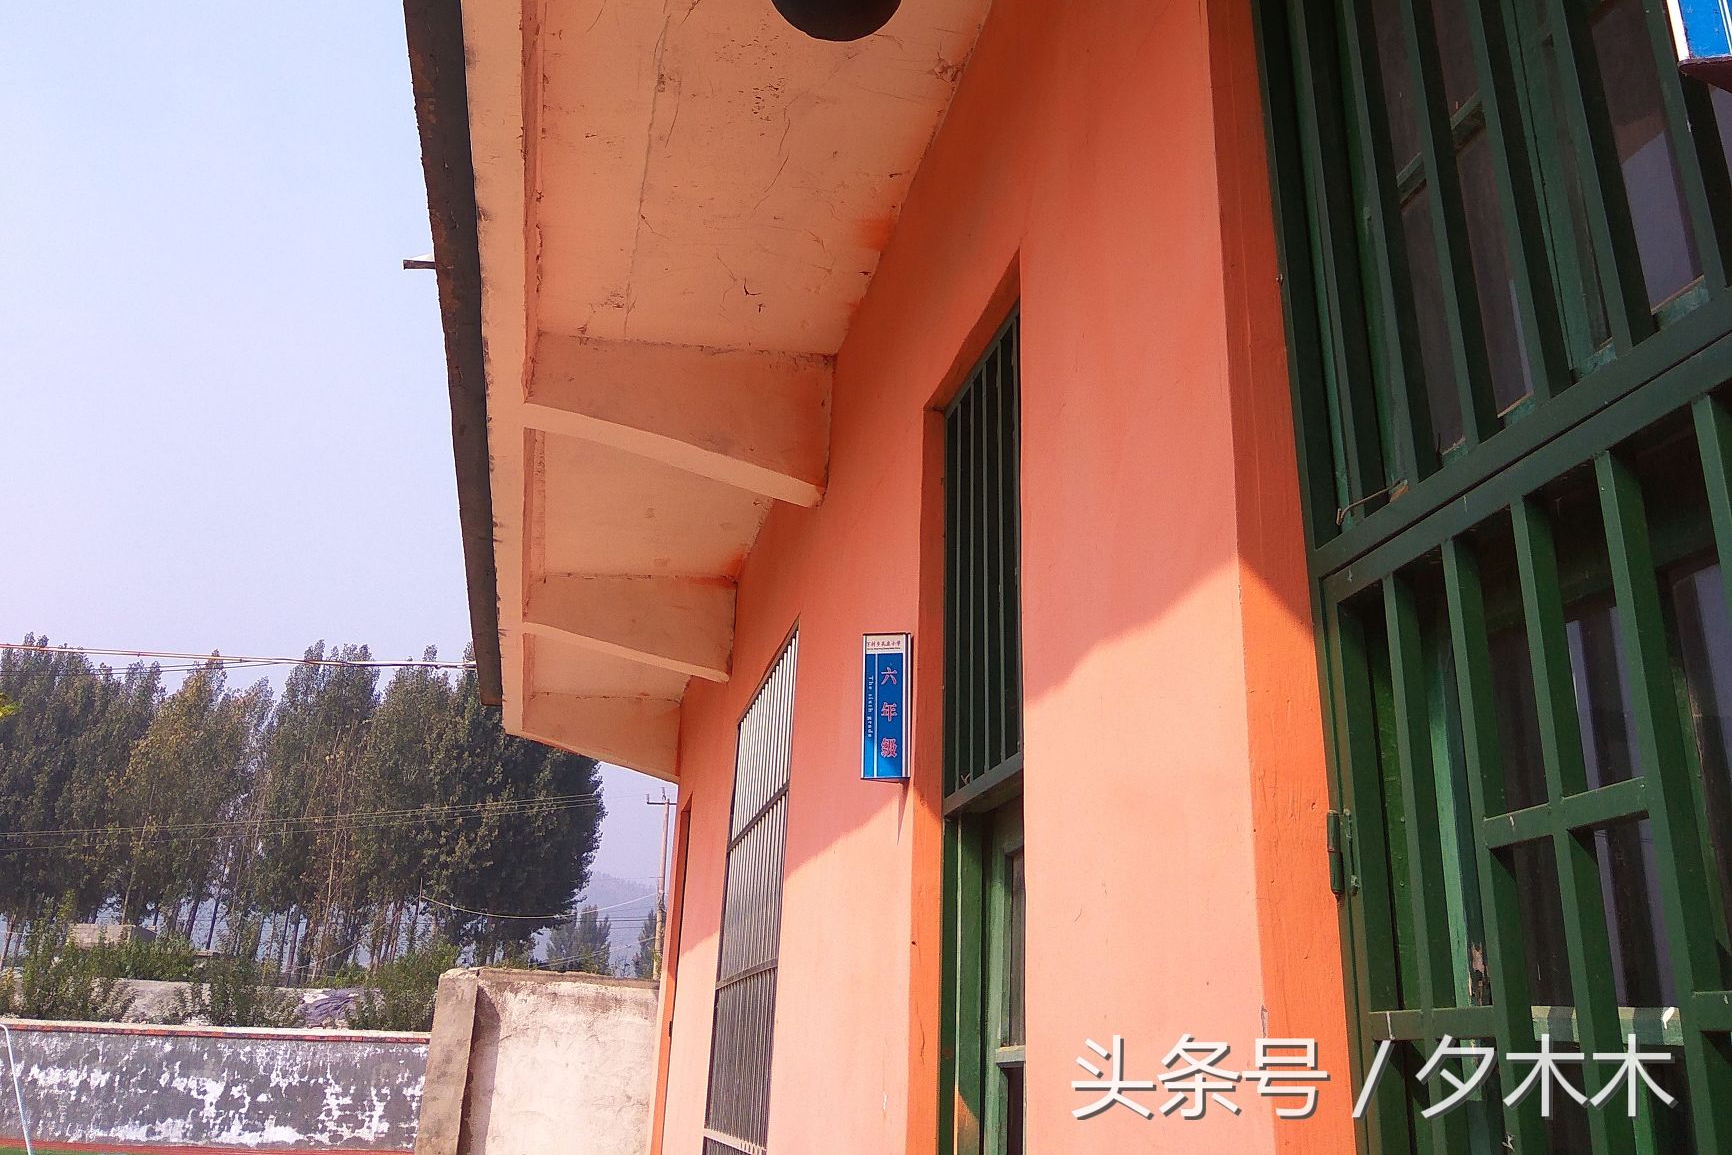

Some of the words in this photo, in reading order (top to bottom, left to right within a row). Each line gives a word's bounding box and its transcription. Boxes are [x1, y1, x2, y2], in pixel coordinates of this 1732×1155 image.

[866, 716, 874, 738] grade
[880, 666, 898, 758] 六年级
